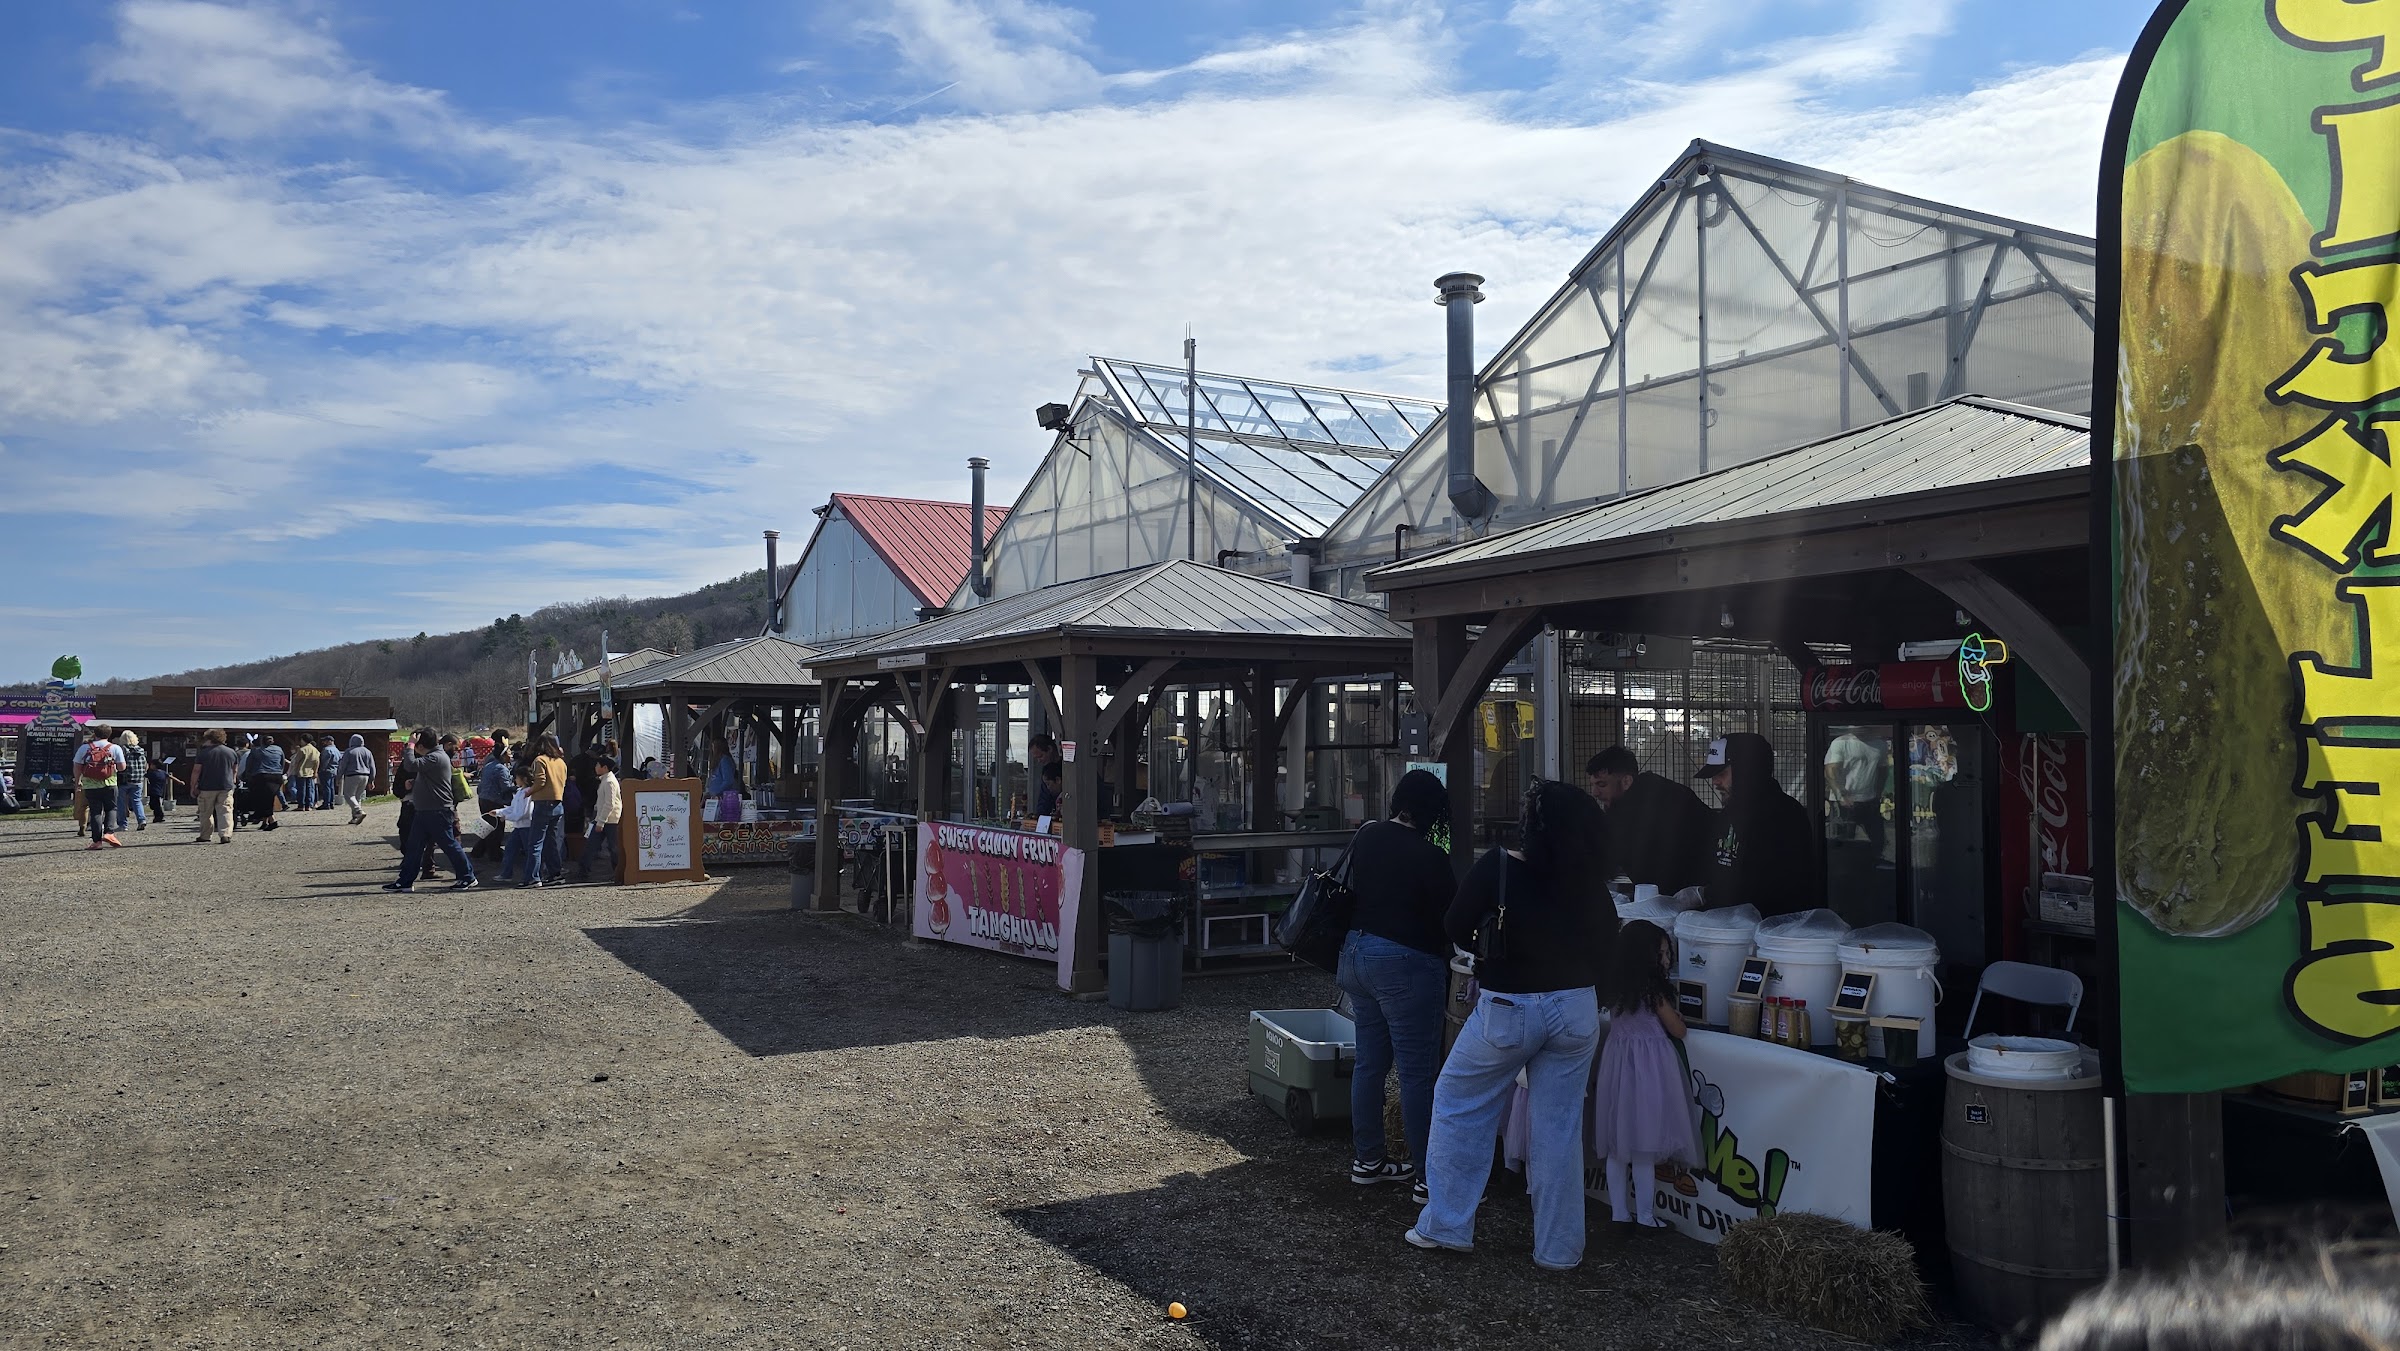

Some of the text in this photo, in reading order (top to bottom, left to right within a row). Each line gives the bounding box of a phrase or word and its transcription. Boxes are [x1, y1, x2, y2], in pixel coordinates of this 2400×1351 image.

[1810, 669, 1881, 708] Coca-Cola
[1902, 680, 1927, 690] enjoy
[10, 700, 42, 708] CORN
[719, 828, 773, 841] GEM
[938, 825, 977, 851] SWEET
[978, 831, 1020, 859] CANDY
[702, 840, 788, 855] MINING
[969, 905, 1059, 952] TANGHULU
[1655, 1190, 1741, 1236] our Dil
